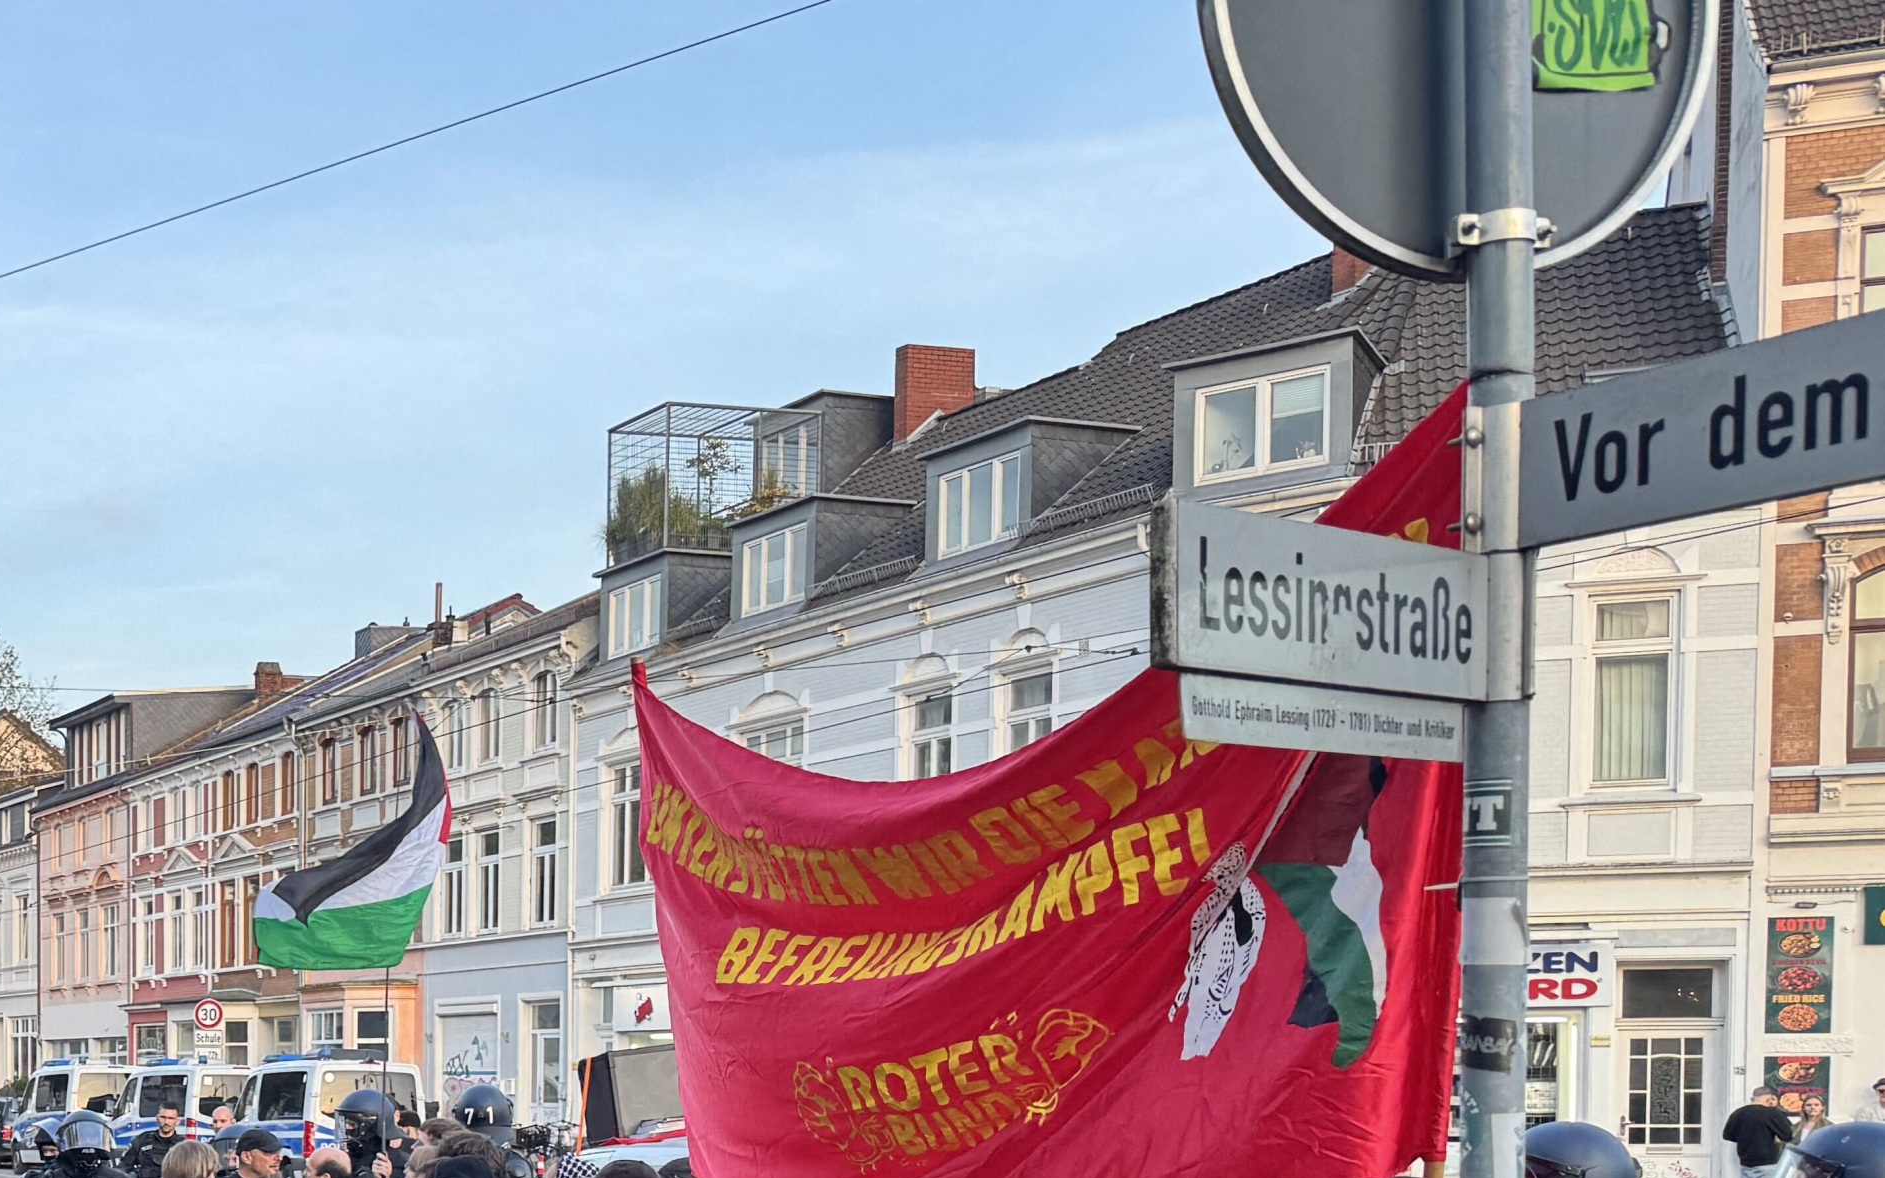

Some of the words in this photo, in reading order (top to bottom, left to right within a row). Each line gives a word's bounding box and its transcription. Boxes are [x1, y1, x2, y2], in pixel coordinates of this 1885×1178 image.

[1554, 411, 1665, 502] Vor
[1709, 373, 1870, 471] dem
[1192, 695, 1231, 719] Gotthold
[1235, 699, 1273, 725] Ephraim
[1276, 704, 1310, 731] Lessing
[1374, 715, 1404, 735] Dichter
[1406, 724, 1423, 738] und
[1424, 720, 1456, 740] Kritiker
[851, 828, 995, 900] WIR
[969, 784, 1096, 867] DIE
[1775, 918, 1827, 932] KOTTU
[1772, 994, 1801, 1003] FRIED
[1802, 994, 1825, 1003] RICE
[200, 1008, 217, 1021] 30
[196, 1033, 222, 1043] Schule
[837, 1033, 1034, 1112] ROTER
